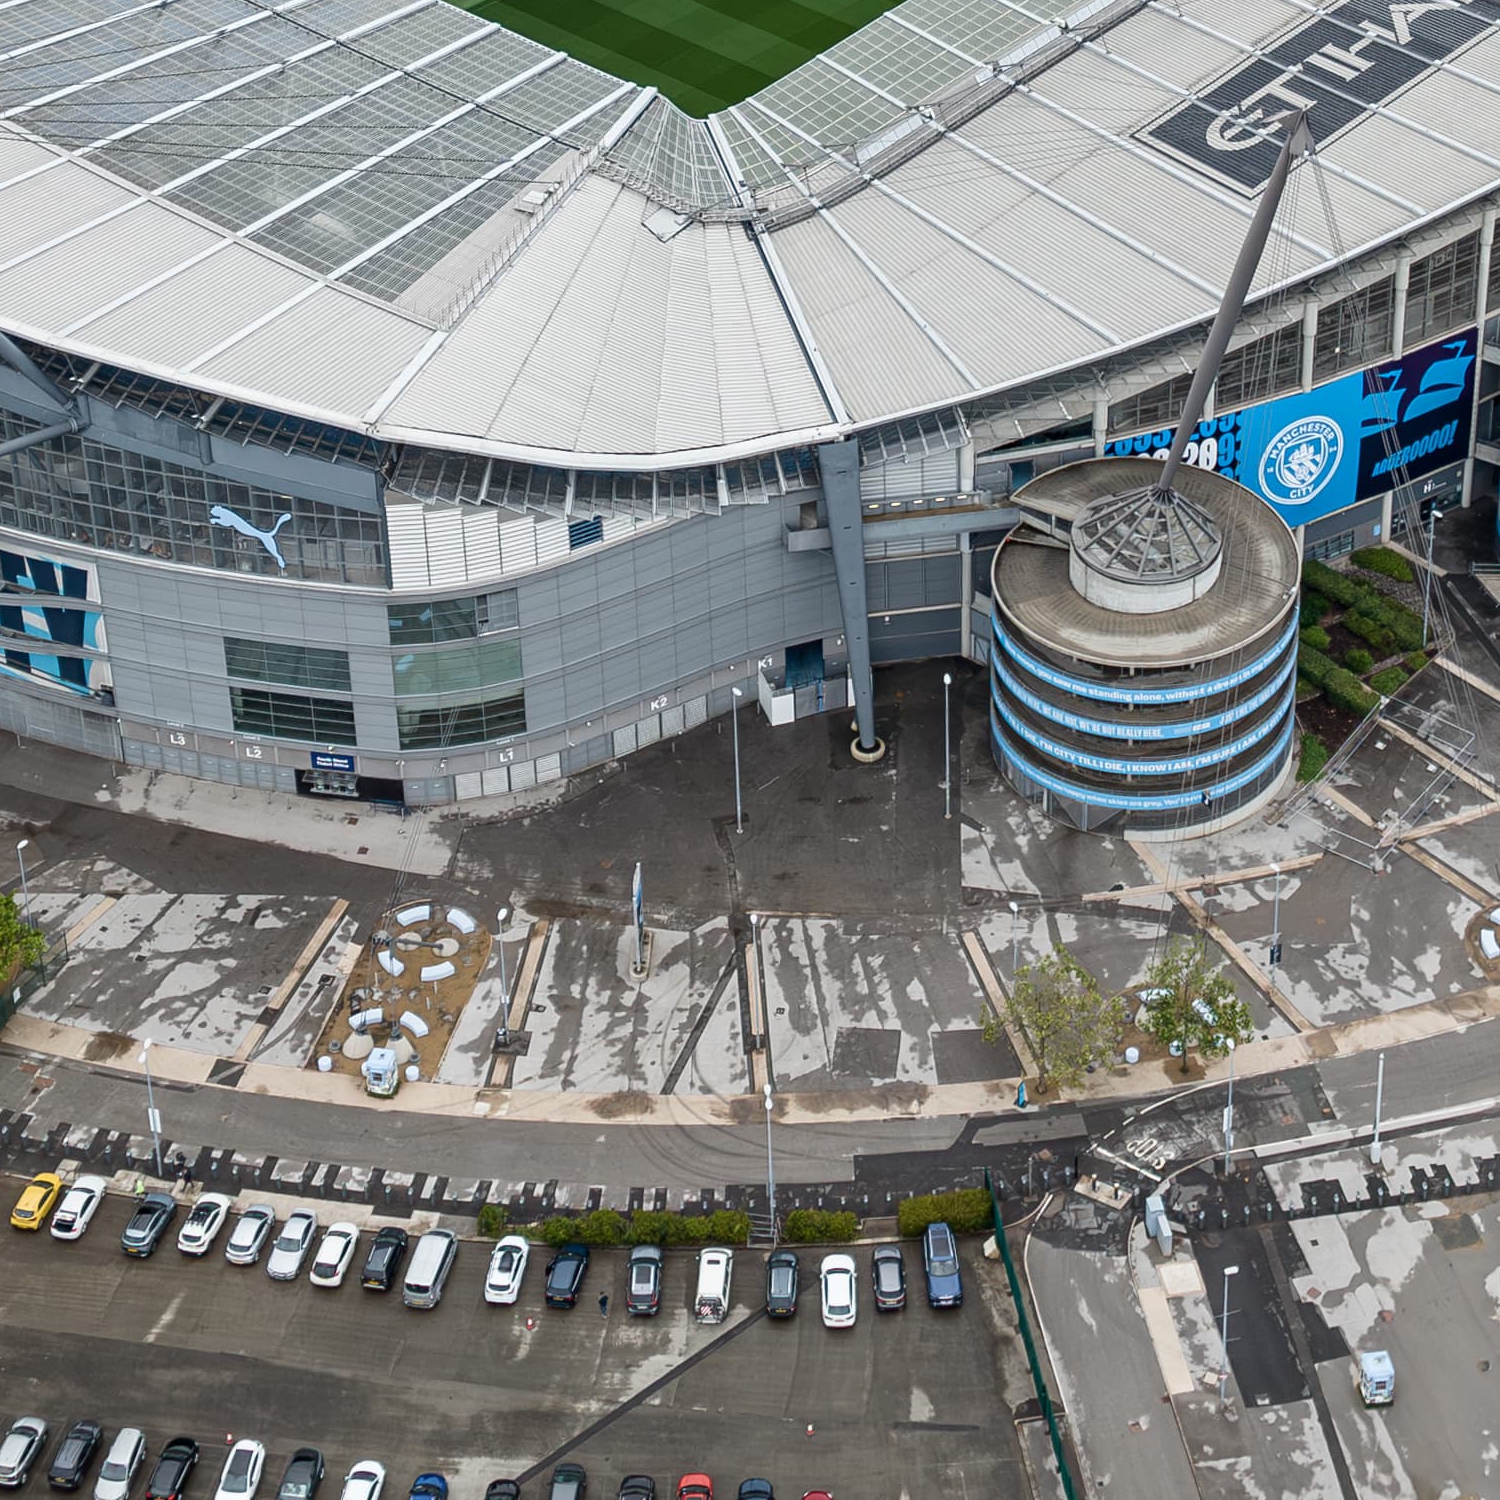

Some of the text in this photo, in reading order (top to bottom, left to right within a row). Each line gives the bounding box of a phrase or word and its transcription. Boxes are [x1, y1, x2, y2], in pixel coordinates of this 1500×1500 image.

[1270, 422, 1335, 460] MANCHESTER
[1290, 484, 1315, 499] CITY
[756, 656, 773, 669] K1
[1088, 688, 1132, 702] standing
[1133, 692, 1164, 702] alone,
[1166, 688, 1205, 700] without
[650, 695, 669, 711] K2
[170, 733, 186, 745] L3
[246, 747, 262, 759] L2
[499, 750, 514, 762] L1
[1054, 748, 1076, 760] CITY
[1078, 755, 1099, 766] TILL
[1104, 762, 1126, 772] DIE,
[1132, 764, 1167, 772] KNOW
[1174, 761, 1194, 771] AM,
[1212, 746, 1238, 761] SURE
